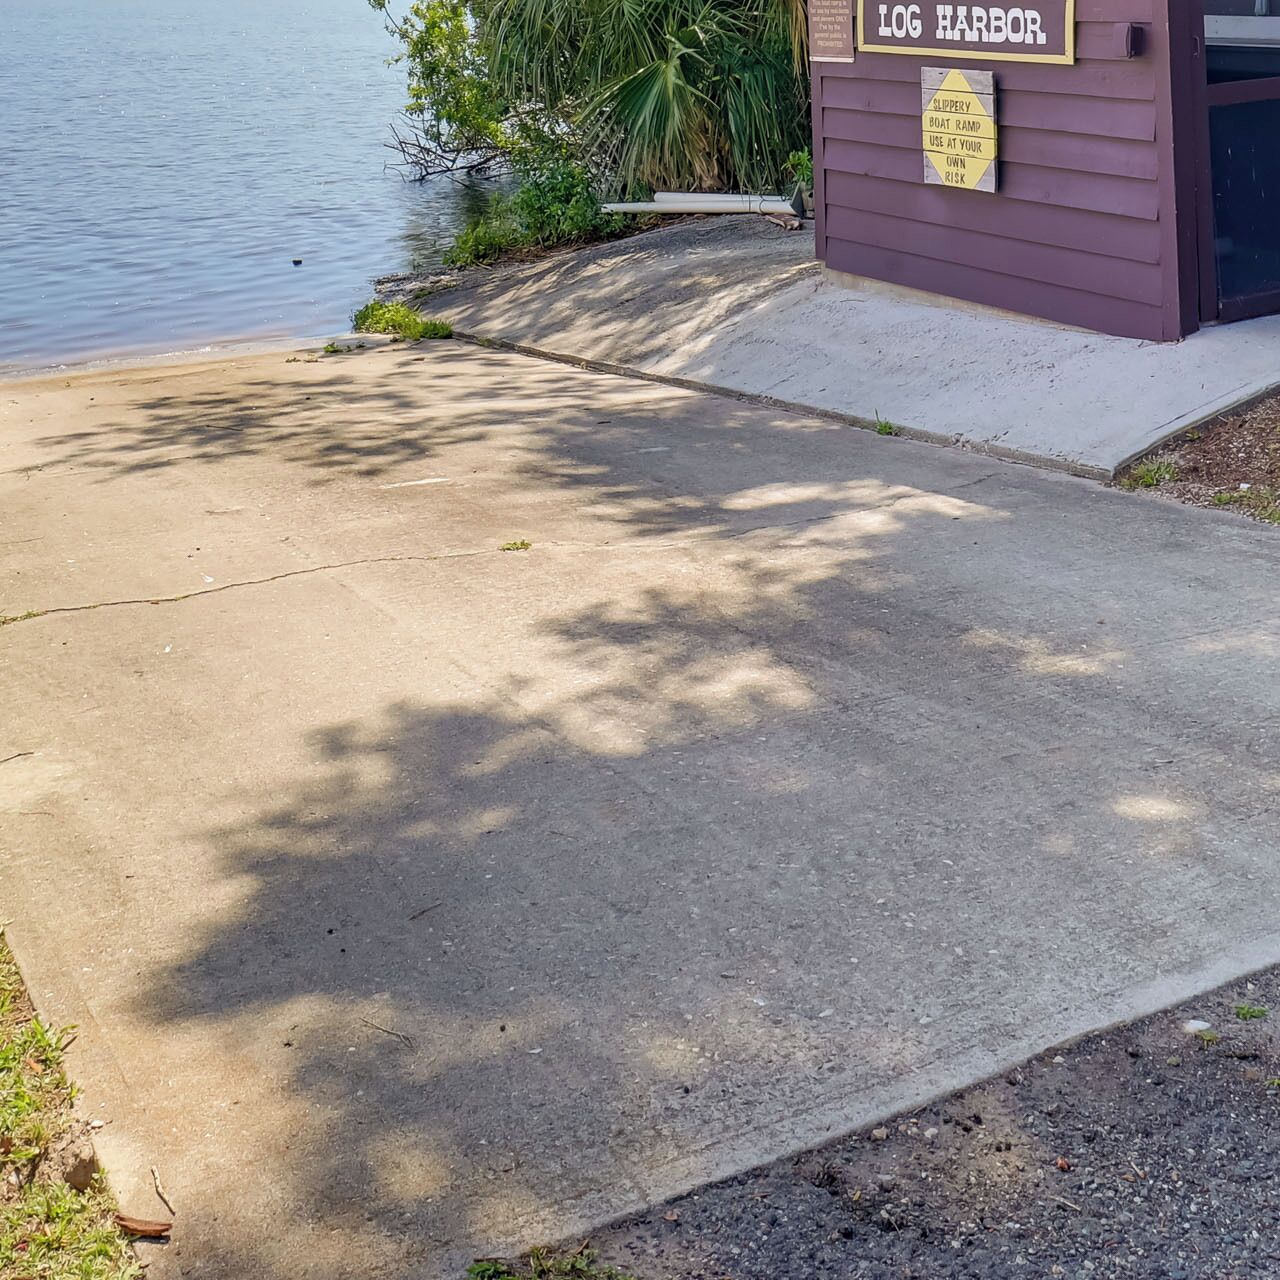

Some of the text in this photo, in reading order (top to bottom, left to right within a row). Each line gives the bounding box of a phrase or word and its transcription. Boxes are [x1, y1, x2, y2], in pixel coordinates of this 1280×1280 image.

[878, 4, 1047, 44] LOG HARBOR
[933, 98, 970, 112] SLIPPERY
[929, 117, 981, 132] BOAT RAMP
[929, 135, 982, 153] USE AT YOUR
[946, 156, 966, 169] OWN
[945, 171, 965, 184] RISK
